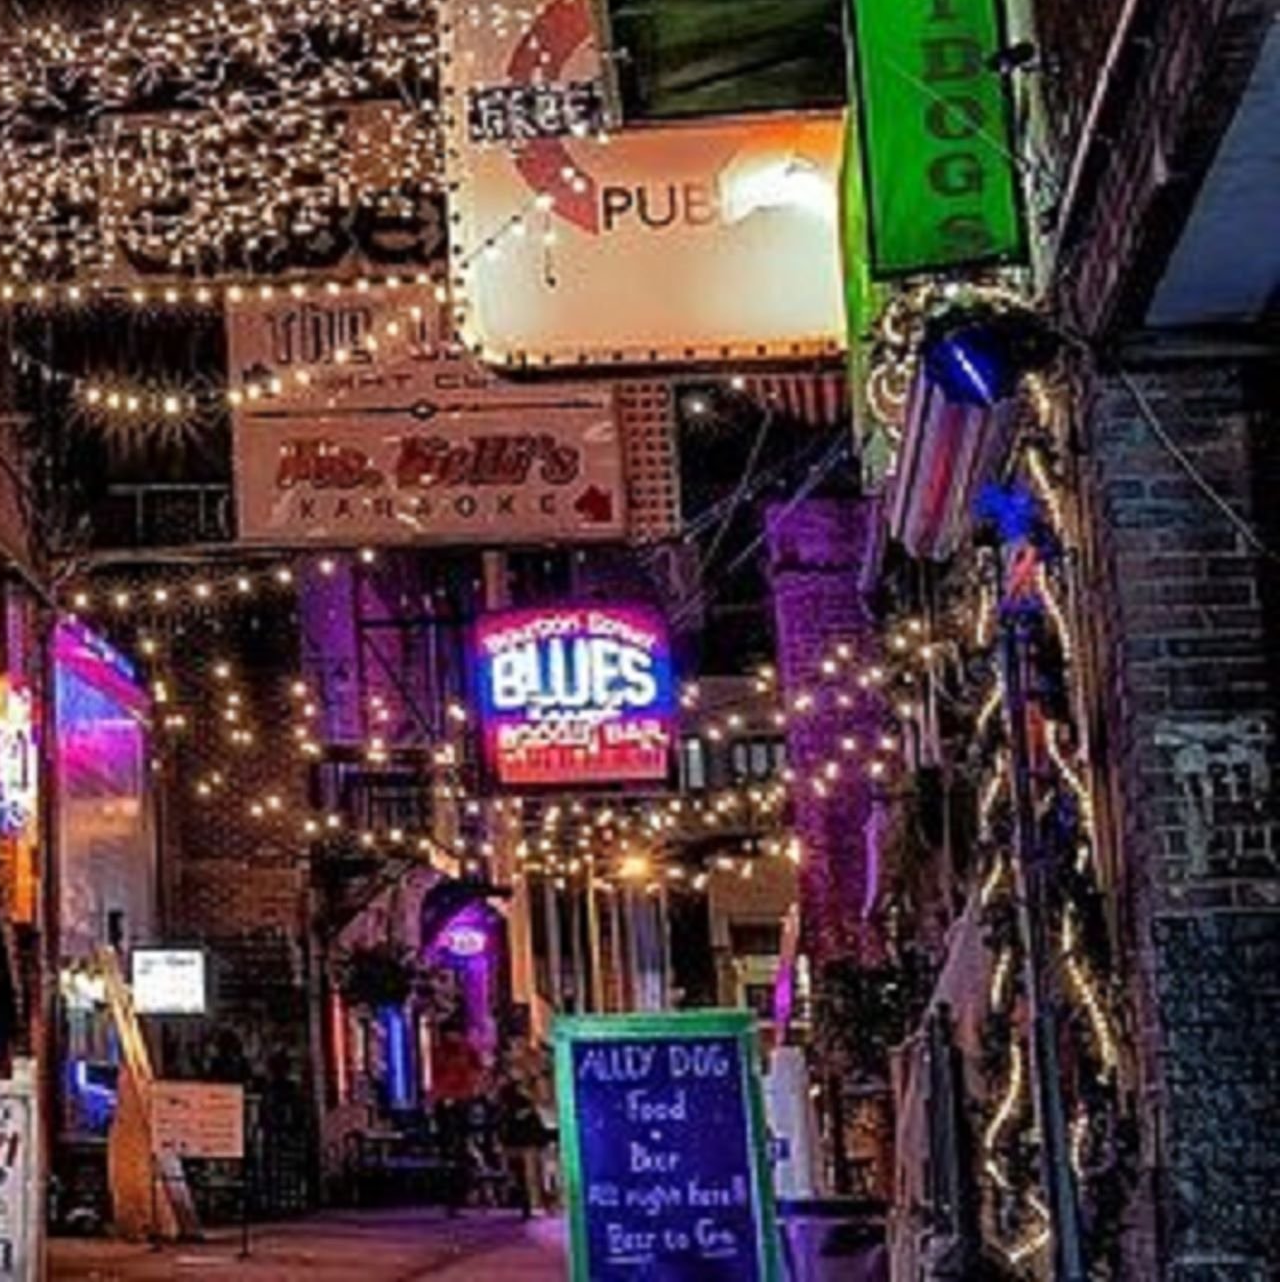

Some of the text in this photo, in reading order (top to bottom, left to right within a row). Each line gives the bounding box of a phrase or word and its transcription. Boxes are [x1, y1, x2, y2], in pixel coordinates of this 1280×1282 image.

[491, 636, 659, 709] BLUES
[668, 1043, 731, 1078] DOG
[626, 1089, 688, 1122] Food
[630, 1140, 681, 1173] Beer
